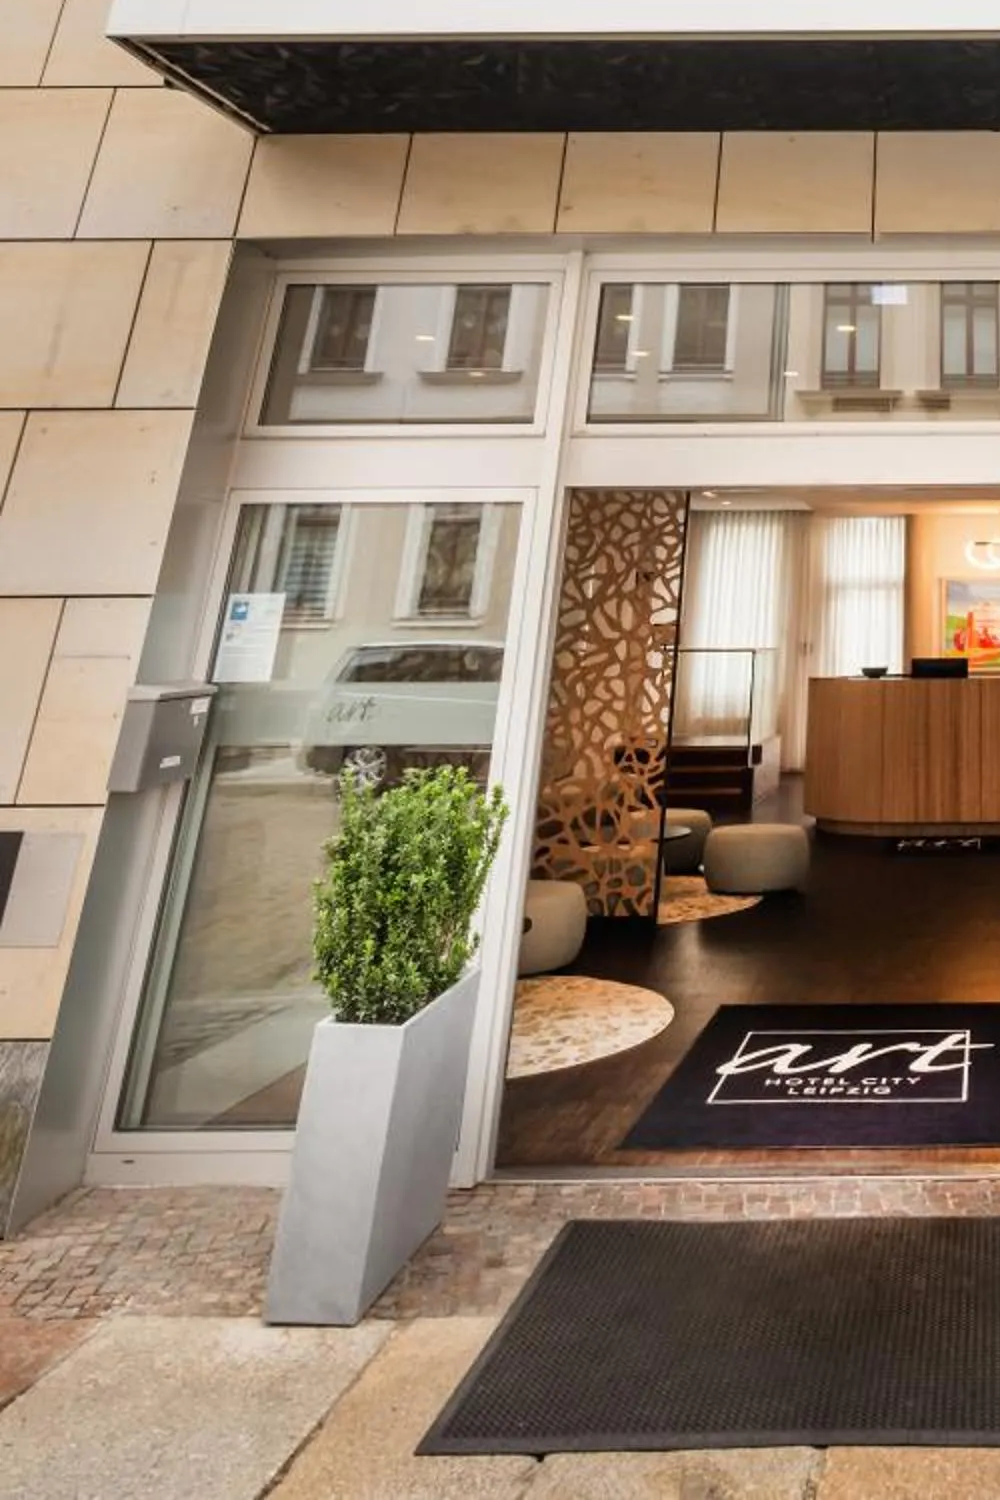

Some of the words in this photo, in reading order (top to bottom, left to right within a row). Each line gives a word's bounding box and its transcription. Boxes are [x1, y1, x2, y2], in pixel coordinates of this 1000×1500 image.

[715, 1032, 995, 1075] art
[764, 1077, 849, 1086] HOTEL
[861, 1076, 921, 1085] CITY
[787, 1086, 891, 1095] LEIPZIG
